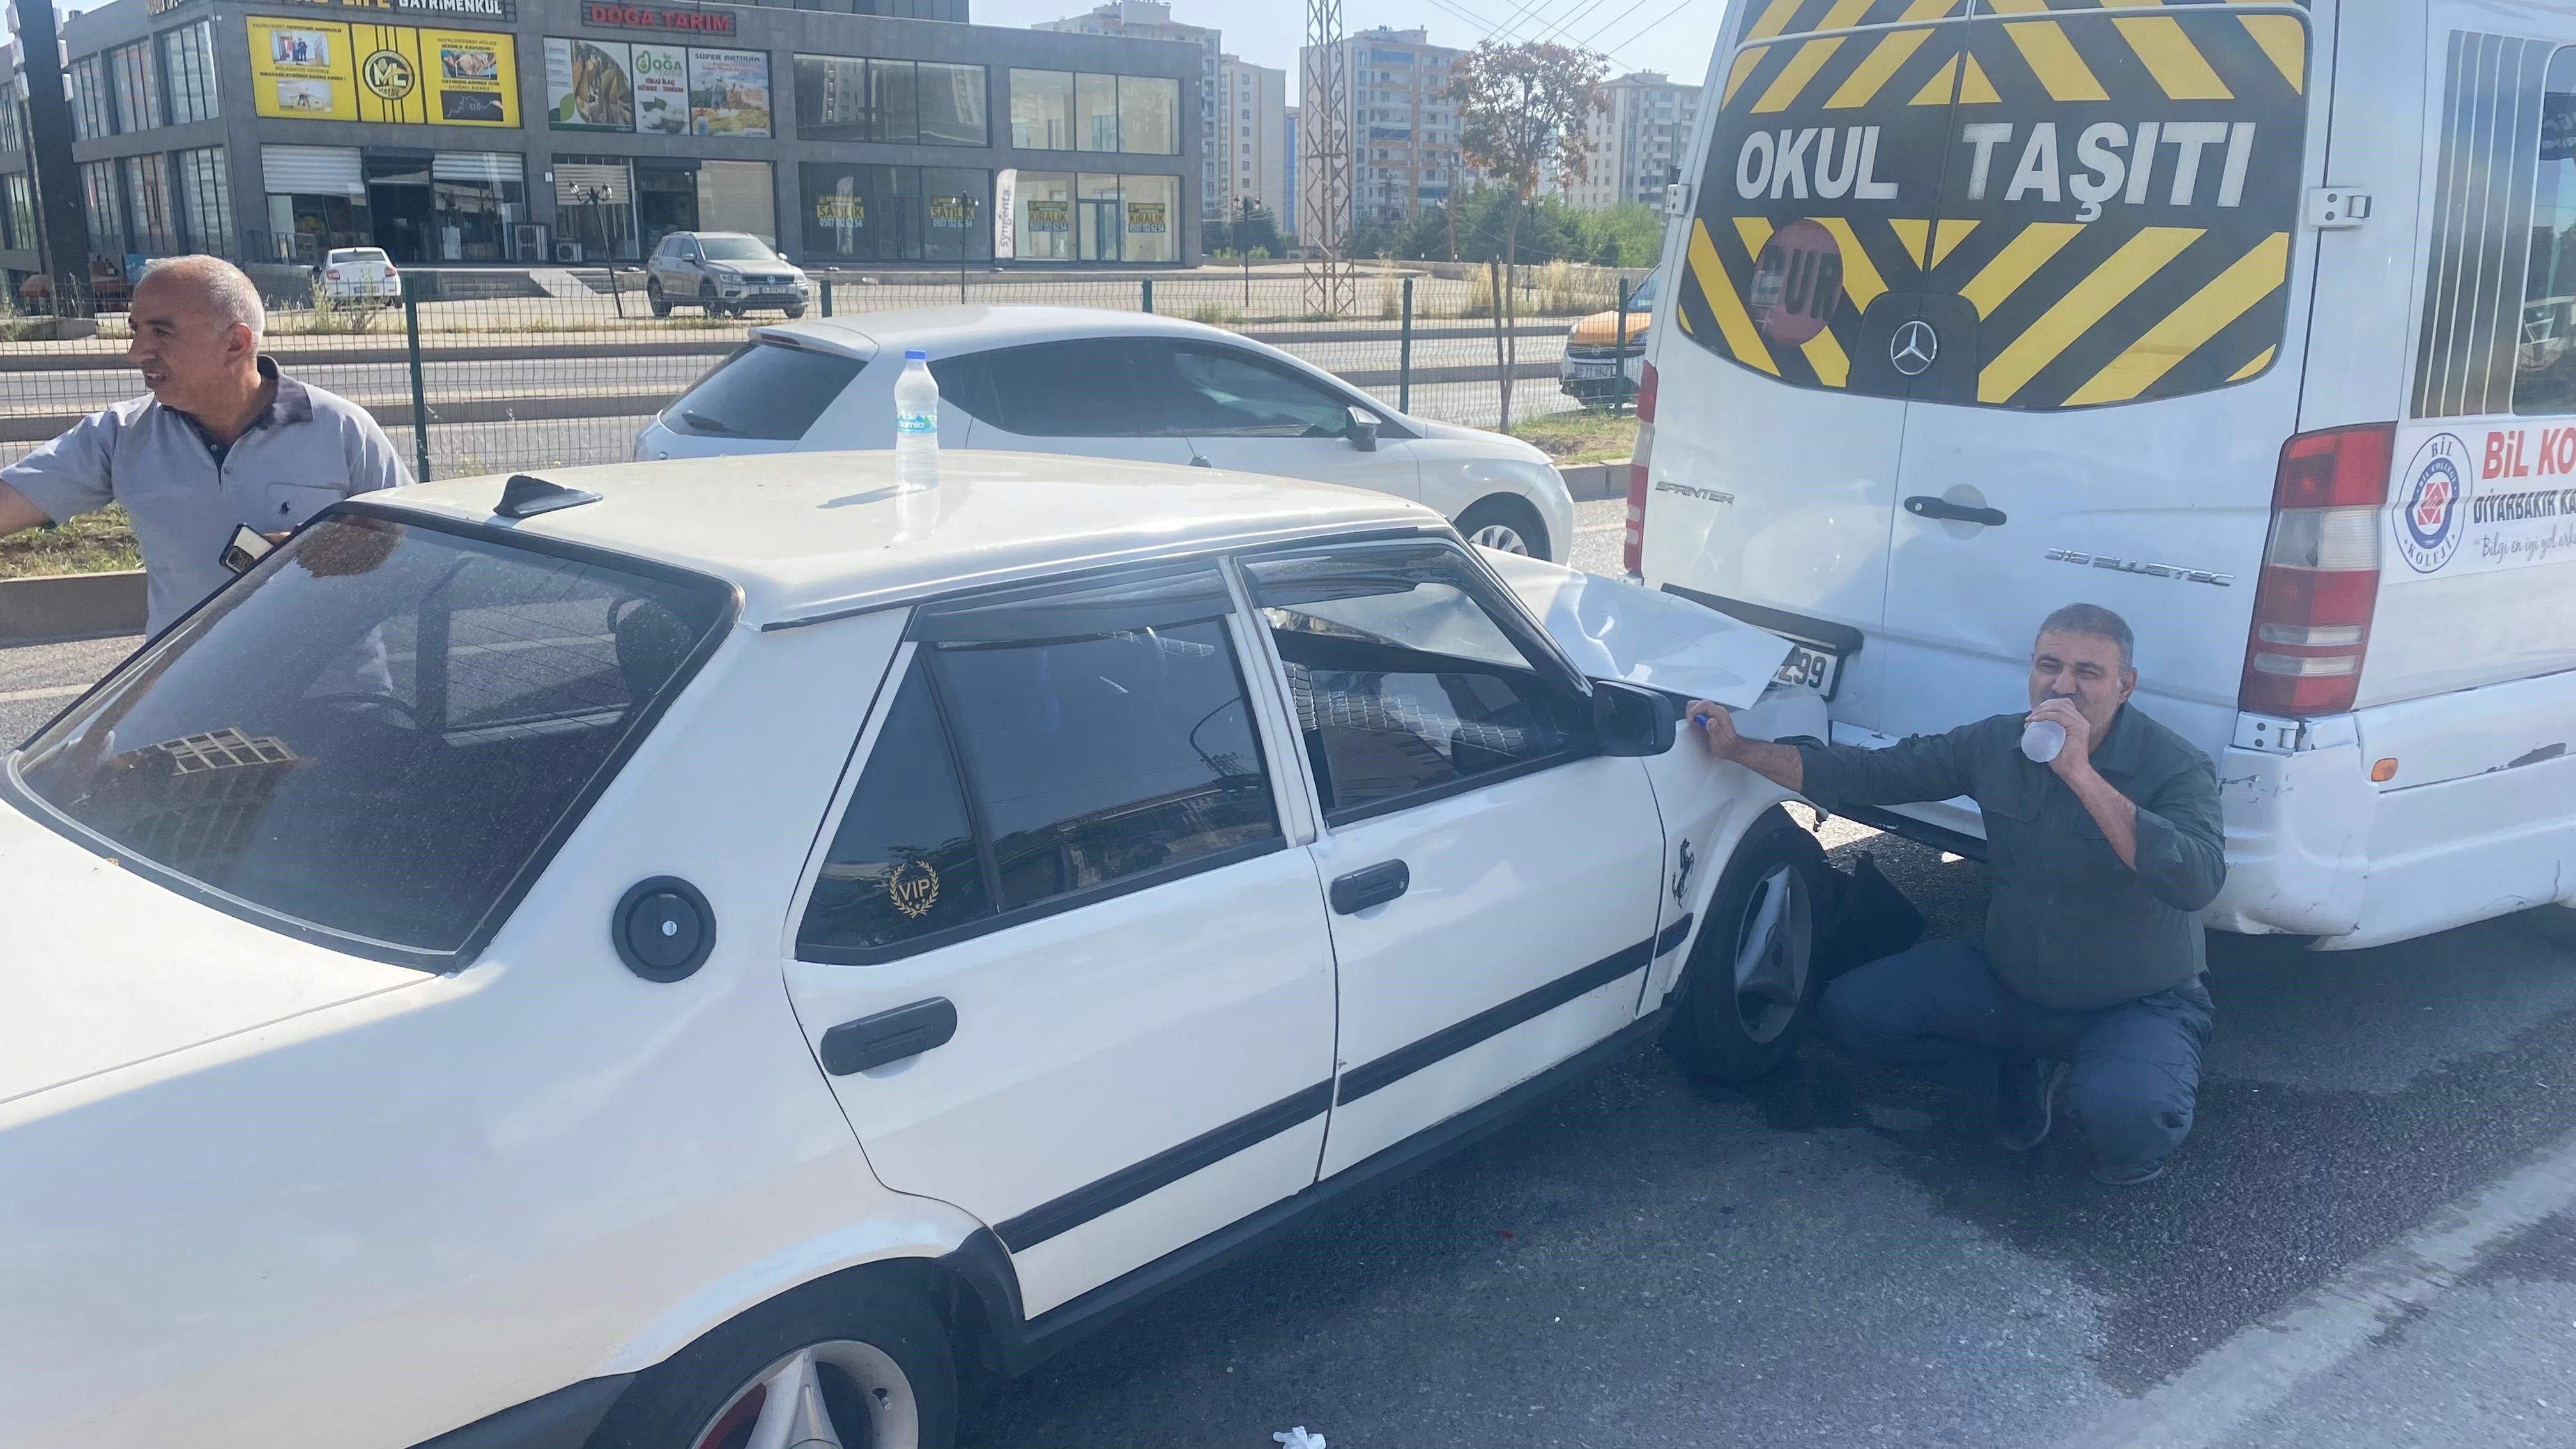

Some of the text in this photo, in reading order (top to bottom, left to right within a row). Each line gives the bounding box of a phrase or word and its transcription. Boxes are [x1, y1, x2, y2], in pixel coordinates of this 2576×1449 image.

[591, 5, 730, 31] DOĞA TARIM
[695, 52, 722, 61] SÜPER
[1735, 121, 2257, 222] OKUL TAŞITI
[819, 206, 862, 218] SATILIK
[933, 207, 974, 218] SATILK
[1000, 189, 1013, 248] syngenta
[898, 420, 924, 429] damla
[2432, 436, 2452, 458] BİL
[1655, 481, 1735, 506] SPRINTER
[2474, 488, 2557, 524] DİYARBAKIR
[898, 878, 930, 901] VIP
